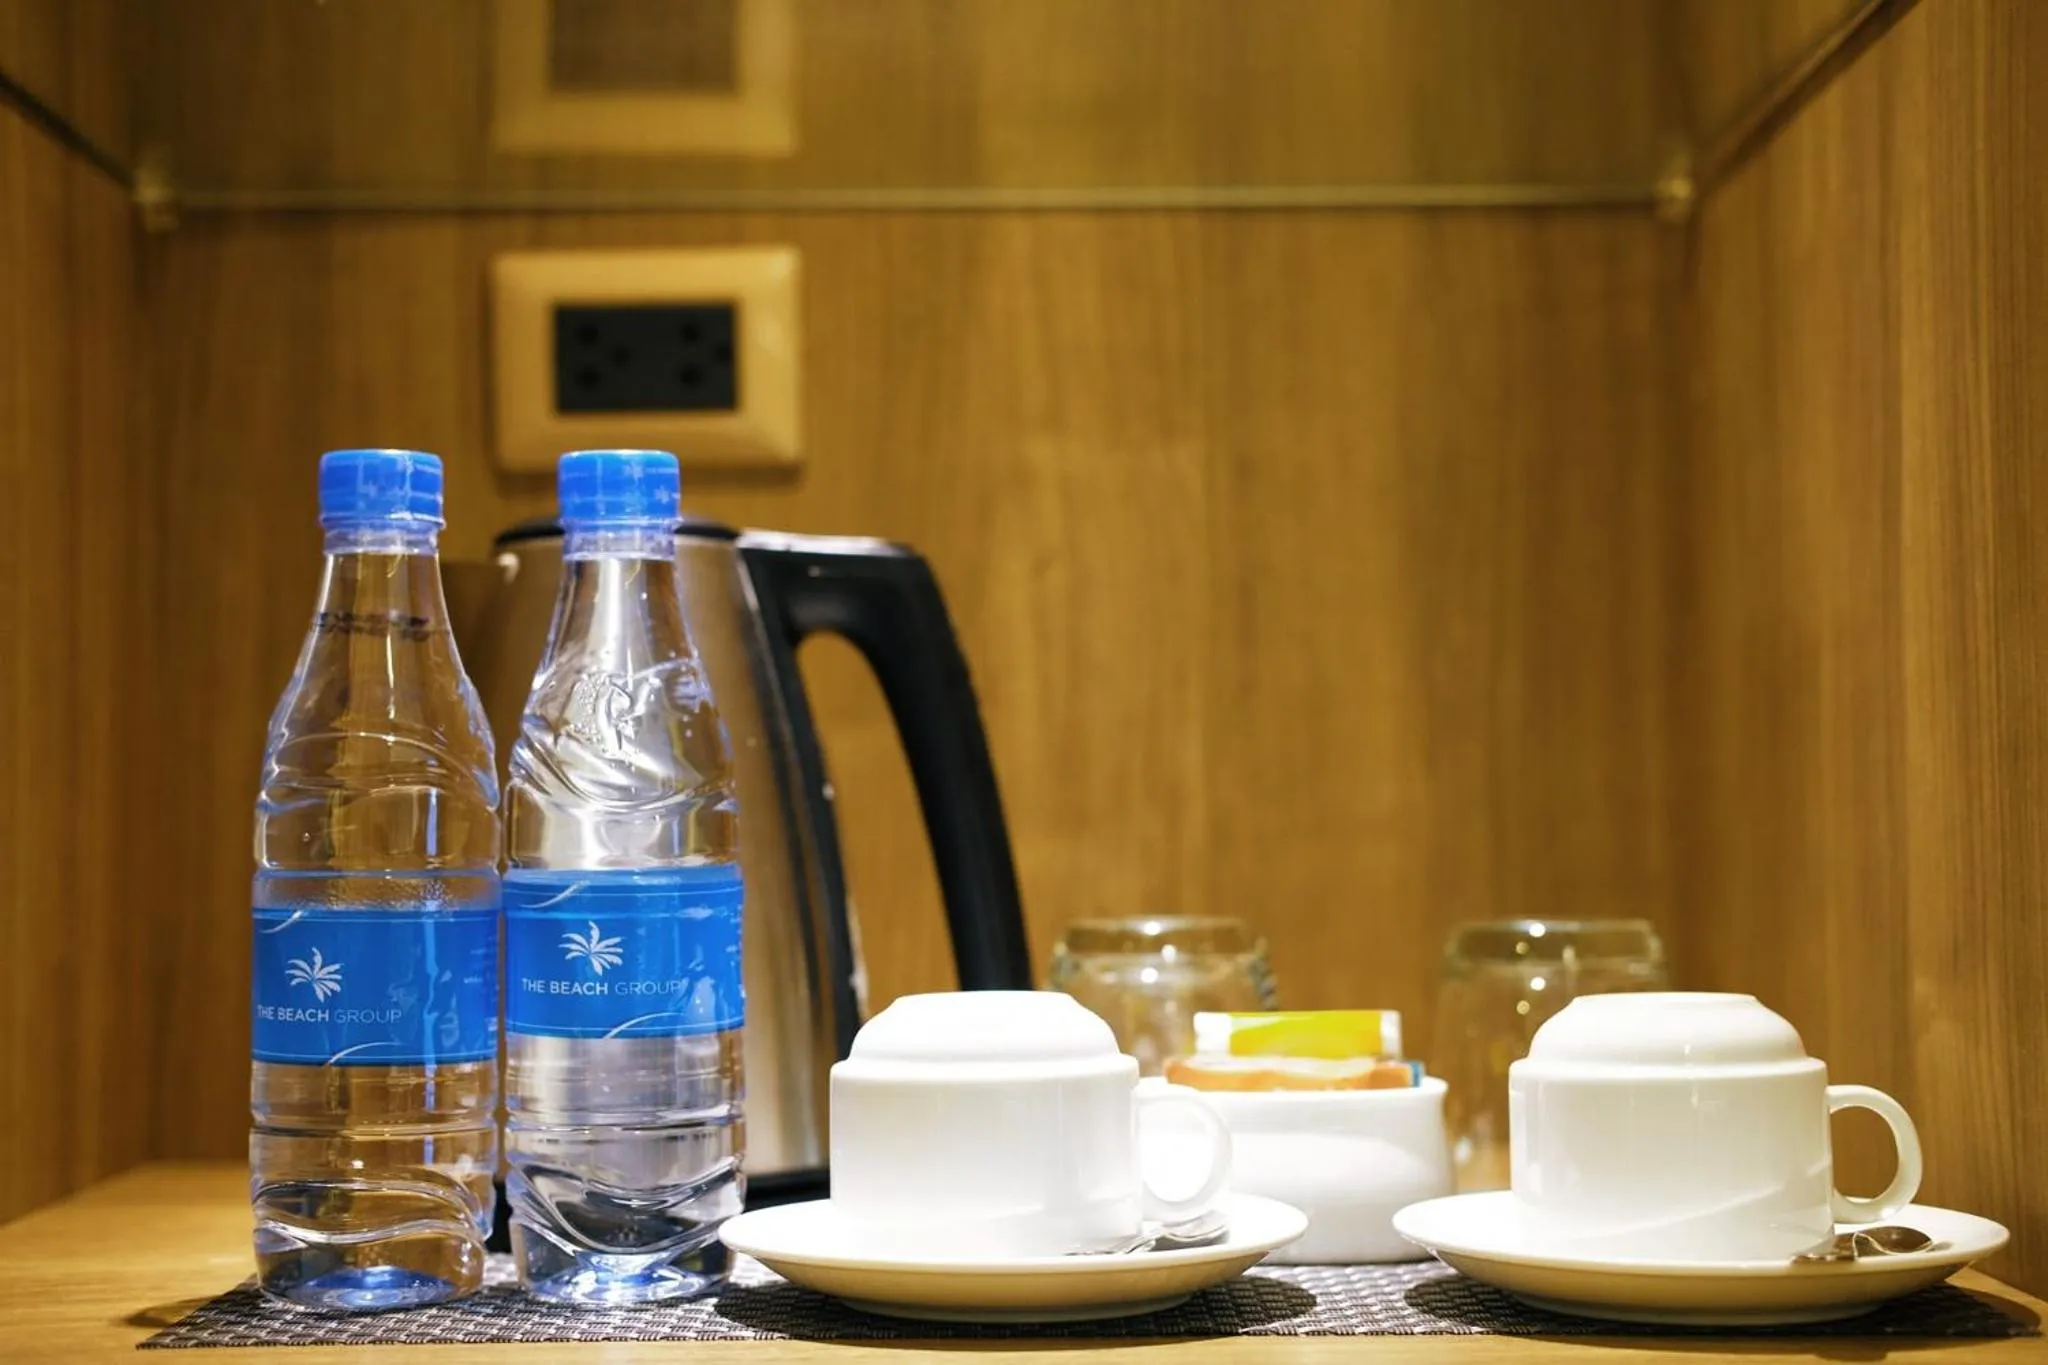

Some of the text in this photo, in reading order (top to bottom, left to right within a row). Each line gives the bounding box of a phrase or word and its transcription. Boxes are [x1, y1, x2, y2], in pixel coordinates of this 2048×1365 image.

[522, 978, 682, 996] THE BEACH GROUP
[257, 1004, 402, 1024] THE BEACH GROUP
